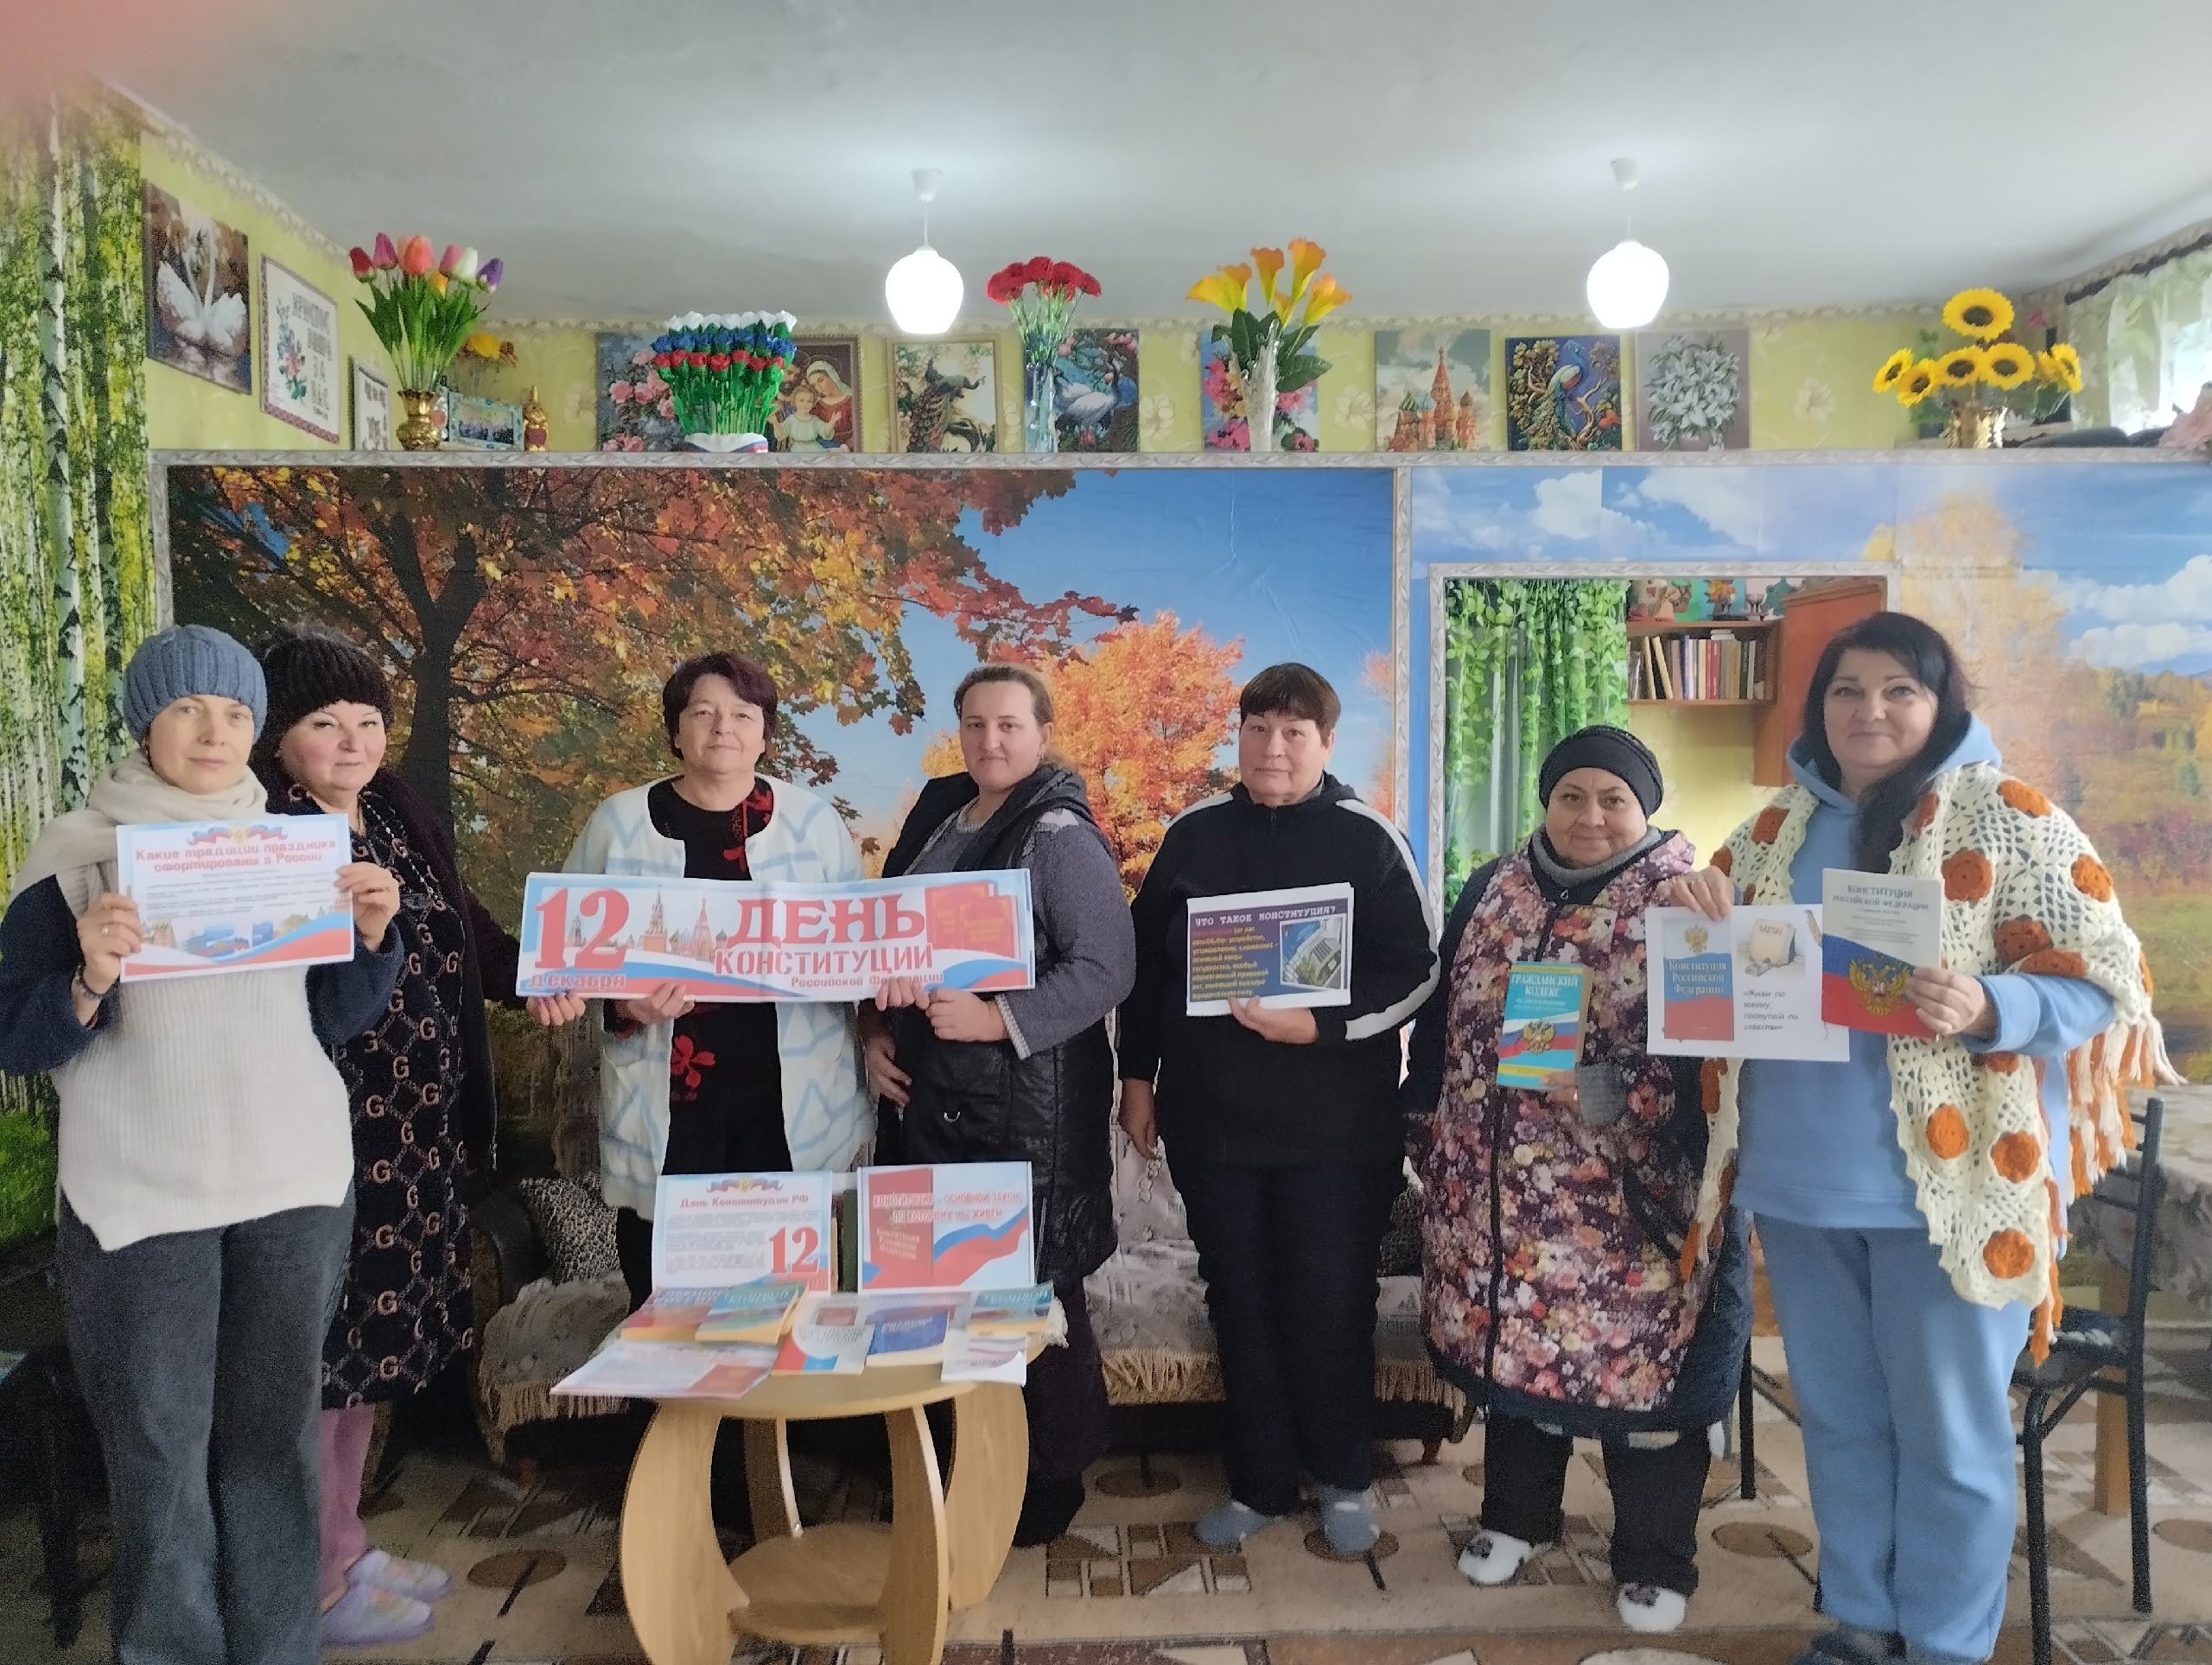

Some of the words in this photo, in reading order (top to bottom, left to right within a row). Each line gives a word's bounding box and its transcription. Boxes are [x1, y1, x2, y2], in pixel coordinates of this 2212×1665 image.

[136, 849, 180, 861] Какие
[185, 846, 259, 860] традиции
[264, 840, 336, 855] праздника
[154, 858, 259, 874] сформированы
[264, 855, 271, 865] в
[276, 851, 321, 864] России
[1833, 894, 1879, 906] РОССИЙСКОЙ
[1883, 899, 1929, 911] ФЕДЕРАЦИИ
[1847, 884, 1913, 898] КОНСТИТУЦИЯ
[726, 893, 925, 949] ДЕНЬ
[1195, 917, 1214, 927] ЧТО
[1219, 913, 1252, 925] ТАКОЕ
[1259, 905, 1336, 922] КОНСТИТУЦИЯ?
[416, 922, 433, 944] G
[534, 887, 630, 969] 12
[409, 952, 423, 975] G
[446, 950, 459, 973] G
[715, 944, 932, 975] КОНСТИТУЦИИ
[1669, 959, 1726, 971] Конституция
[528, 973, 626, 992] декабря
[791, 975, 863, 988] Российской
[1510, 973, 1580, 987] ГРАЖДАНСКИЙ
[1672, 971, 1725, 983] Российской
[1674, 982, 1724, 995] Федерации
[388, 988, 404, 1012] G
[1525, 986, 1561, 997] КОДЕКС
[1743, 988, 1771, 998] «Живи
[419, 1016, 436, 1040] G
[1743, 1012, 1785, 1022] поступай
[393, 1055, 410, 1079] G
[422, 1082, 440, 1106] G
[365, 1094, 385, 1119] G
[400, 1121, 415, 1145] G
[428, 1146, 442, 1171] G
[372, 1159, 391, 1184] G
[406, 1185, 419, 1210] G
[680, 1198, 708, 1209] День
[712, 1196, 789, 1208] Конституции
[792, 1193, 809, 1204] РФ
[944, 1192, 989, 1204] ОСНОВНОЙ
[426, 1211, 441, 1236] G
[375, 1223, 395, 1249] G
[768, 1226, 819, 1274] 12
[410, 1250, 423, 1274] G
[377, 1289, 398, 1316] G
[379, 1355, 399, 1380] G
